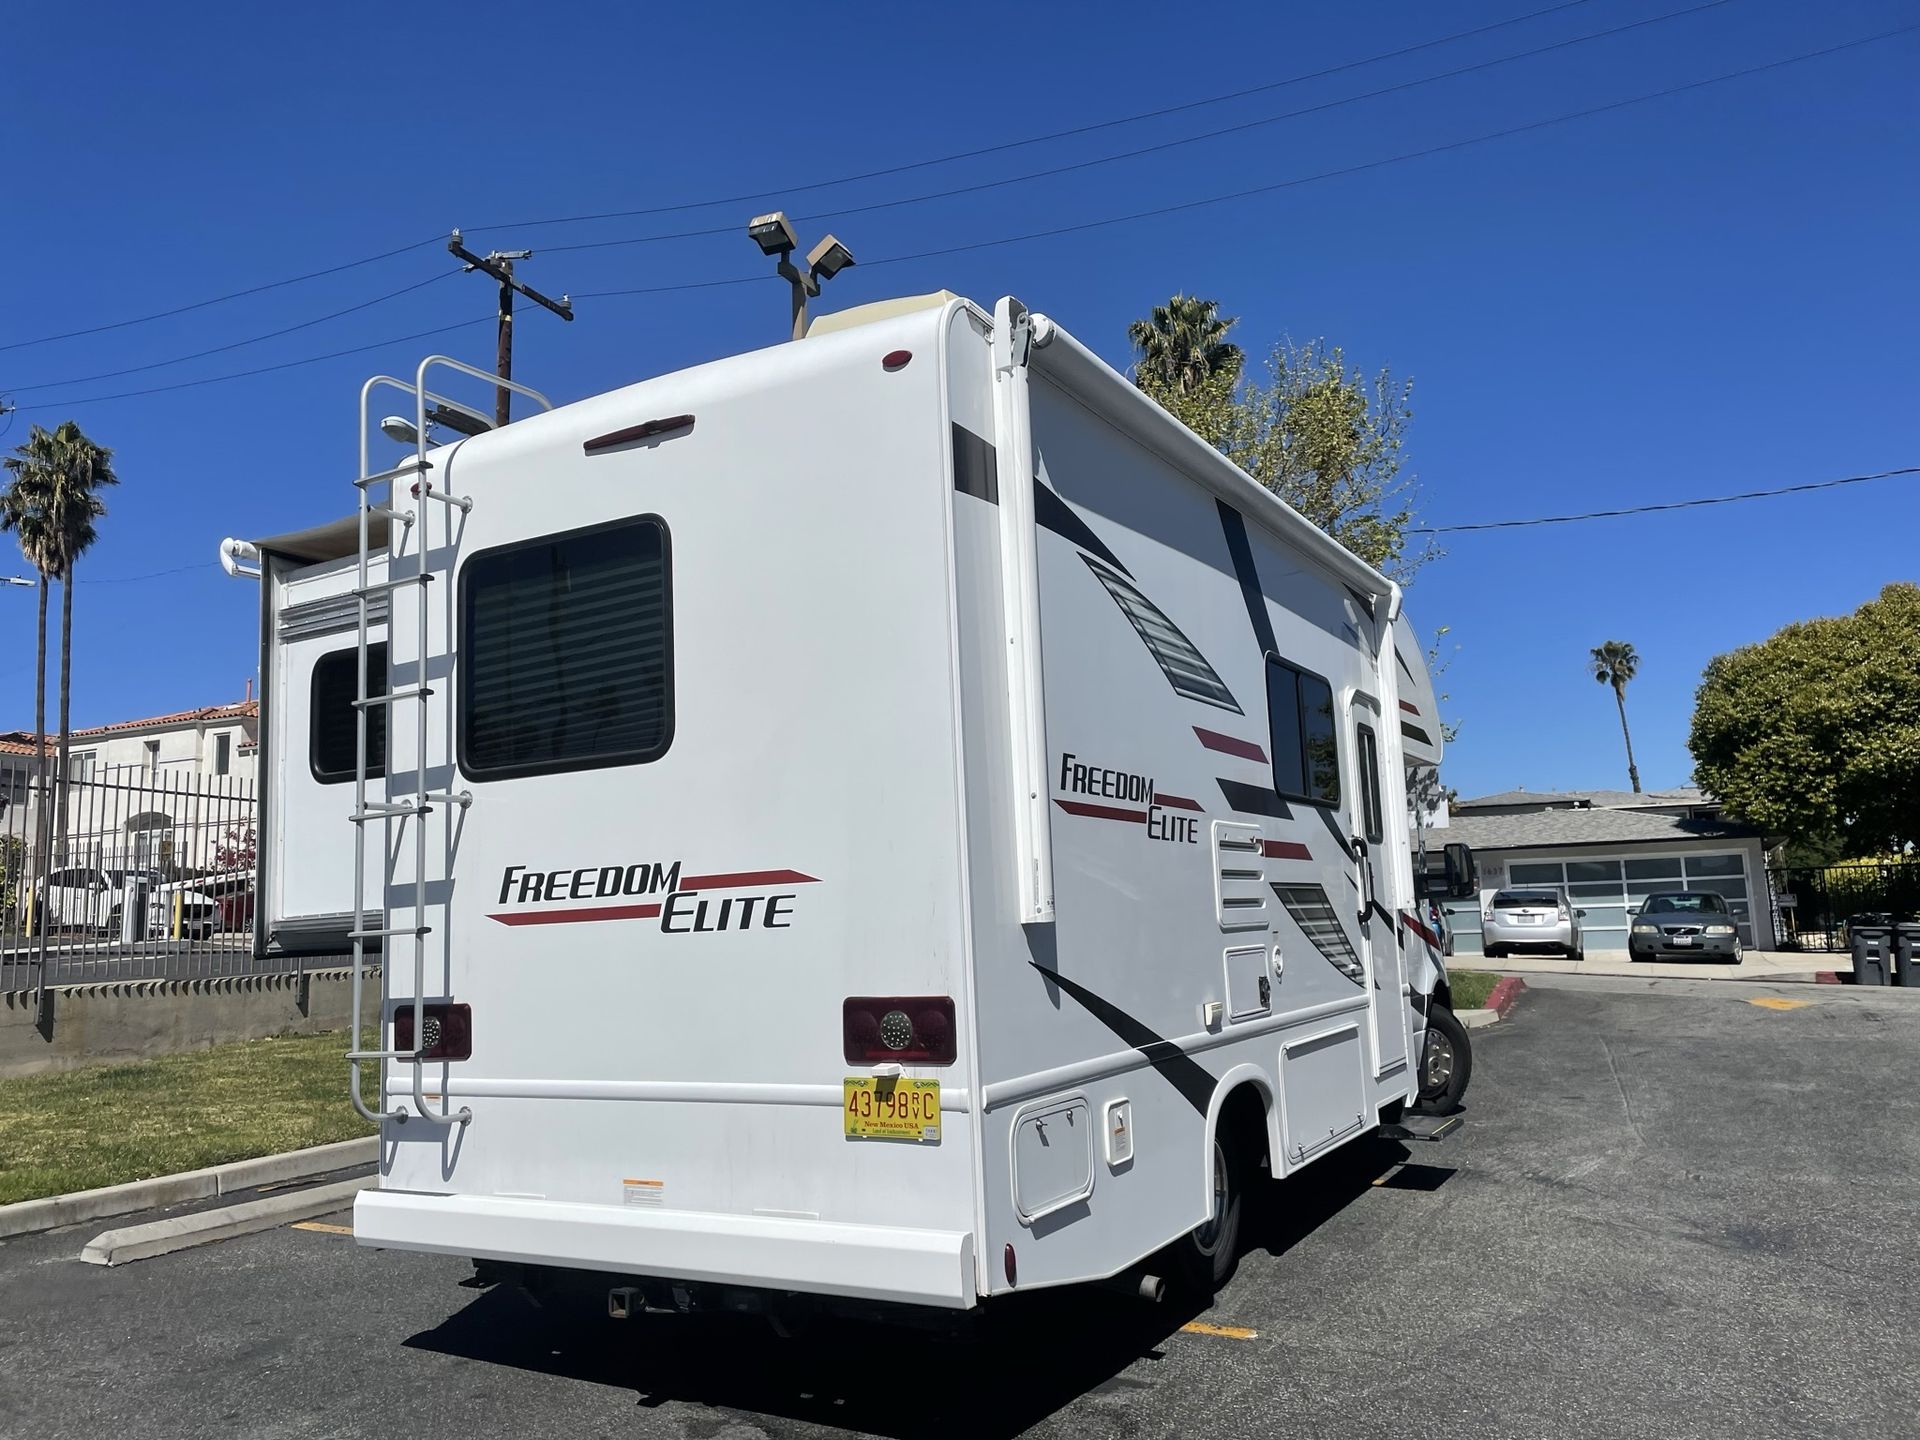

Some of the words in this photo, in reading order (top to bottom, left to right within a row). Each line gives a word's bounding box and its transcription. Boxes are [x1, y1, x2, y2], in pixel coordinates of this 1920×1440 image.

[1060, 752, 1154, 805] FREEDOM
[1147, 805, 1198, 844] ELITE
[498, 860, 682, 905] FREEDOM
[660, 891, 797, 934] ELITE
